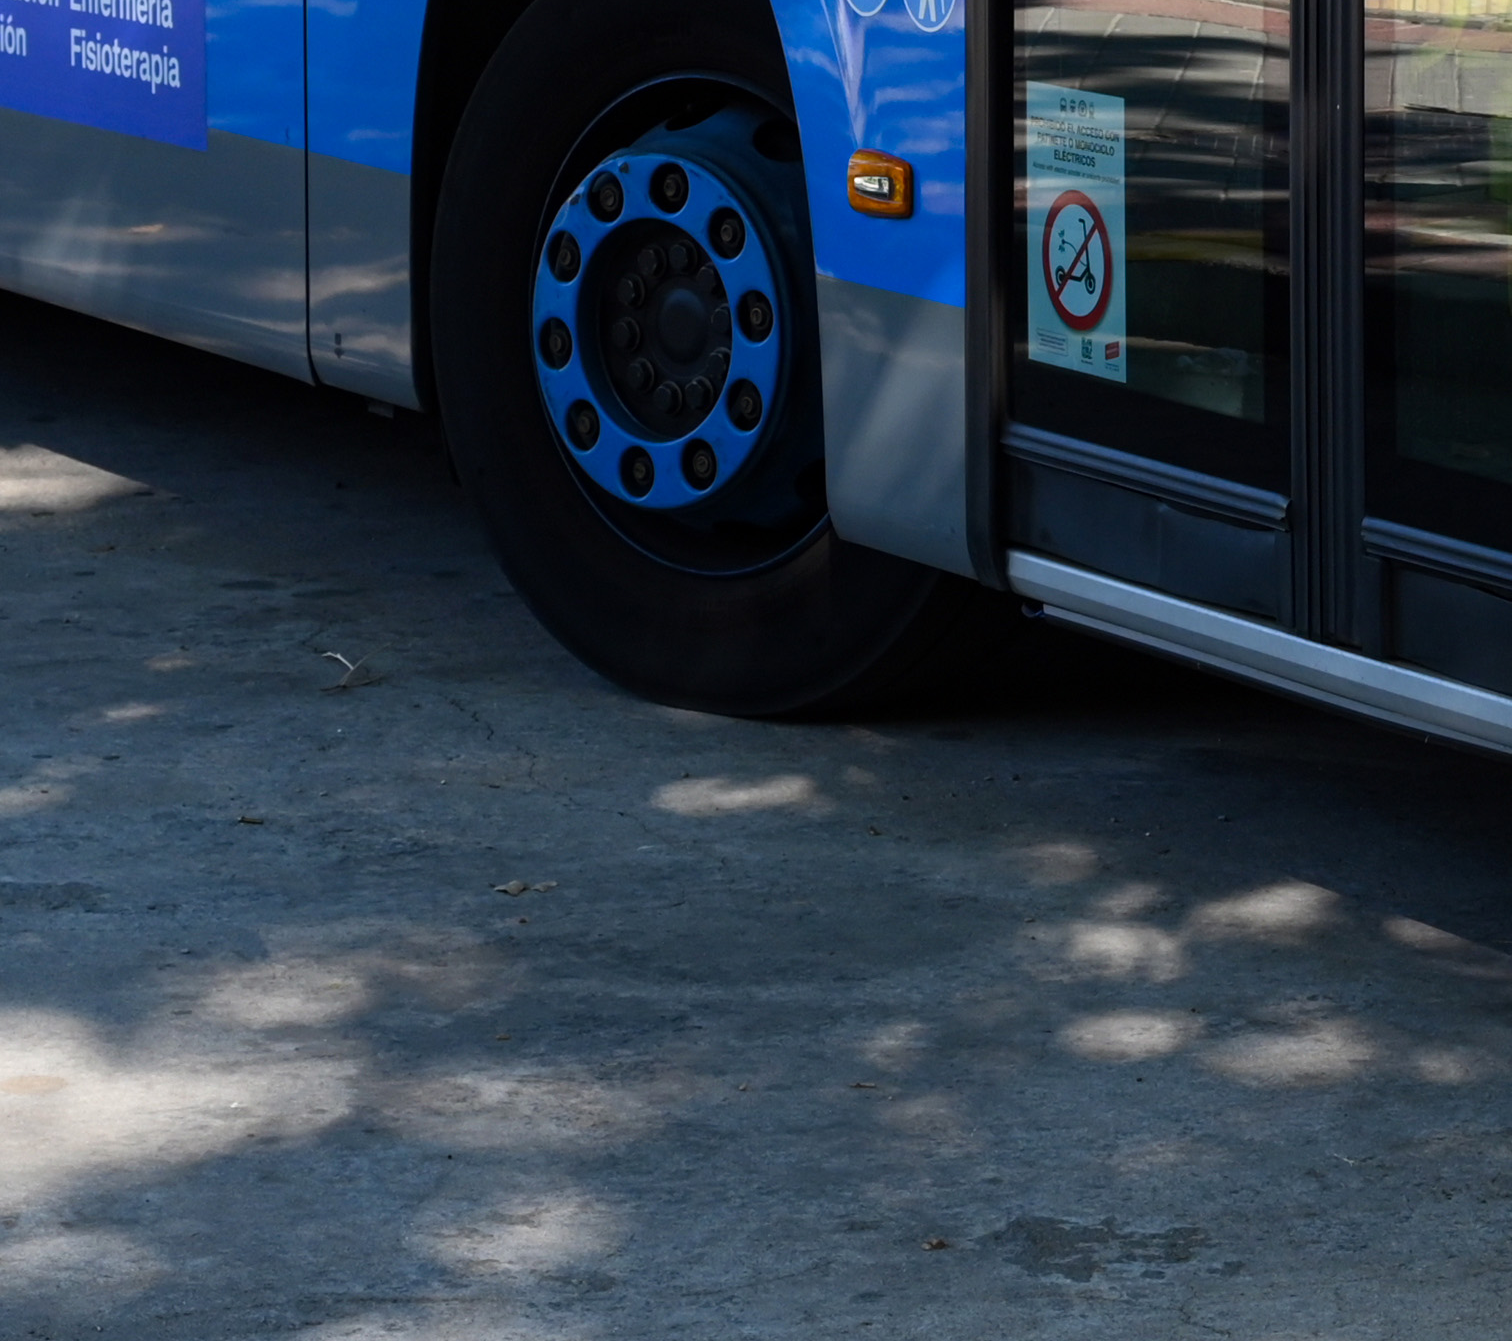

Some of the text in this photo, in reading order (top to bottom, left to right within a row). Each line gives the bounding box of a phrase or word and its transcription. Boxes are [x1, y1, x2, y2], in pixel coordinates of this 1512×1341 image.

[70, 28, 181, 94] Fisioterapia
[1067, 123, 1076, 135] EL
[1076, 125, 1104, 140] ACCESO
[1104, 129, 1120, 143] CON
[1068, 137, 1074, 149] O
[1075, 139, 1116, 157] MONOCICLO
[1053, 148, 1096, 168] ELÉCTRICOS
